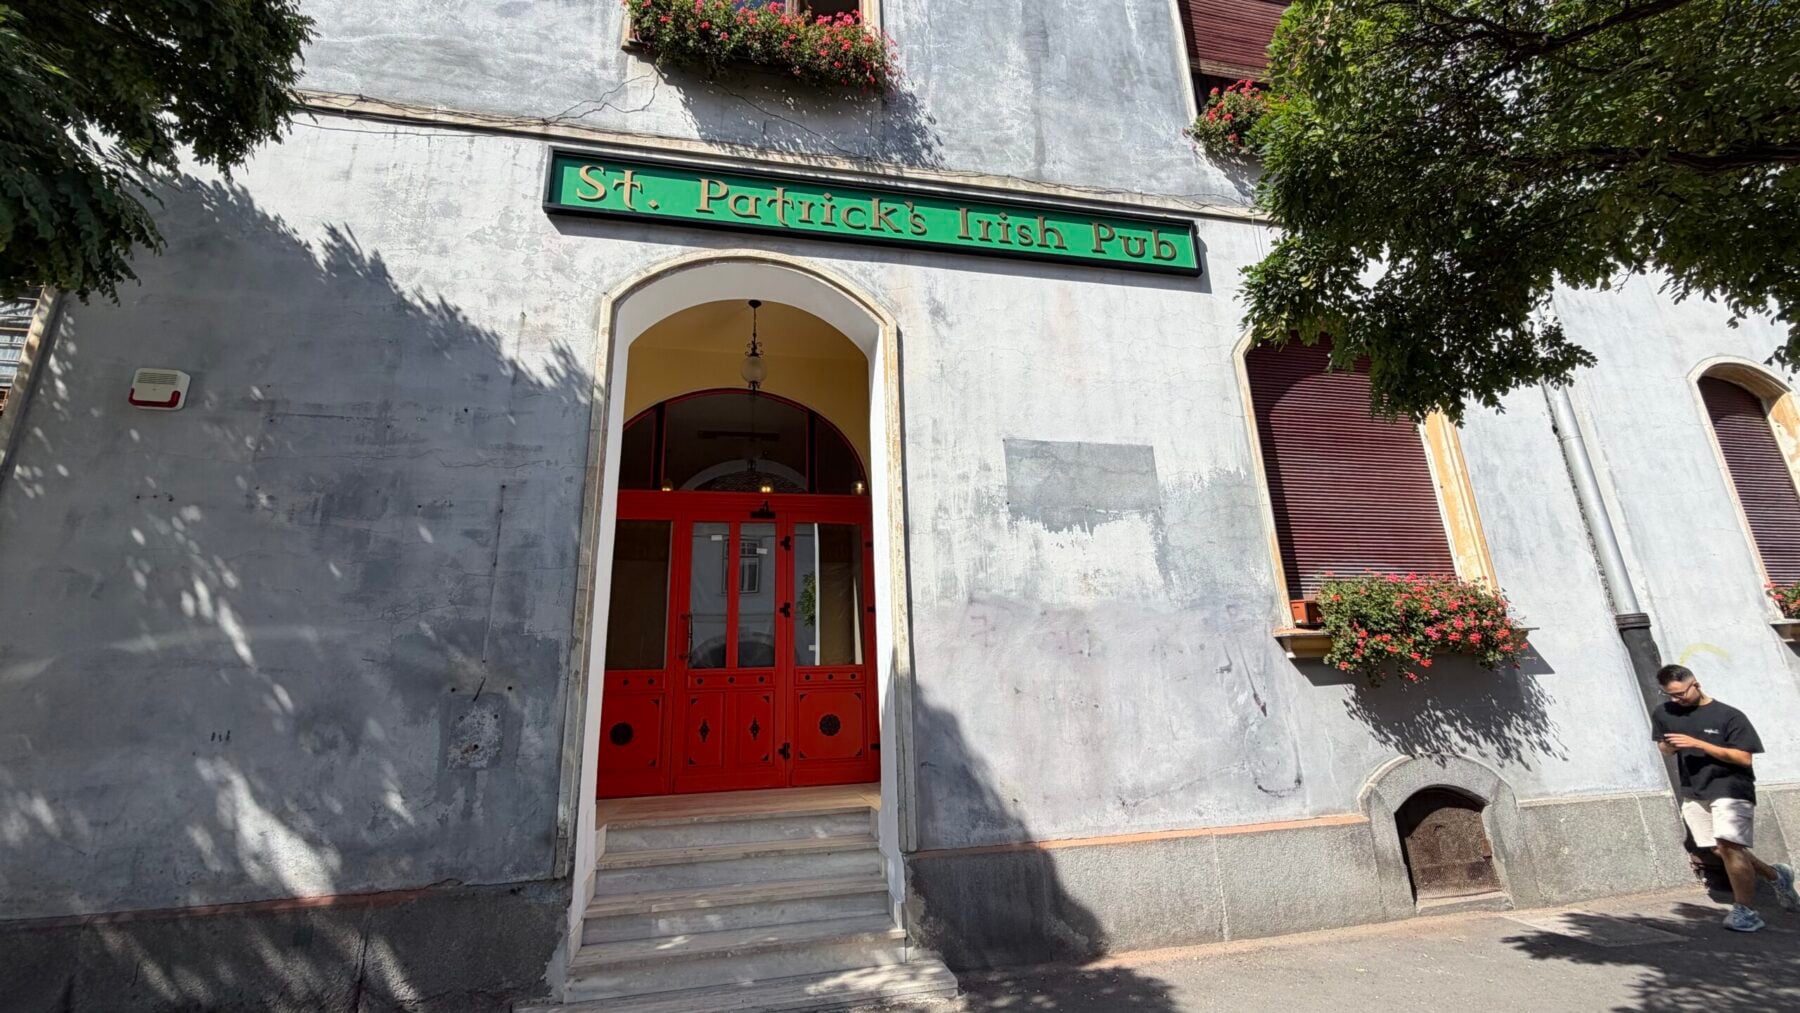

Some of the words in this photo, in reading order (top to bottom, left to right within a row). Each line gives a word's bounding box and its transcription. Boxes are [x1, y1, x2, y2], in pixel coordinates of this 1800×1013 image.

[575, 164, 659, 211] St.
[695, 178, 928, 236] Patrick's
[957, 207, 1068, 250] Irish
[1090, 221, 1178, 261] Pub
